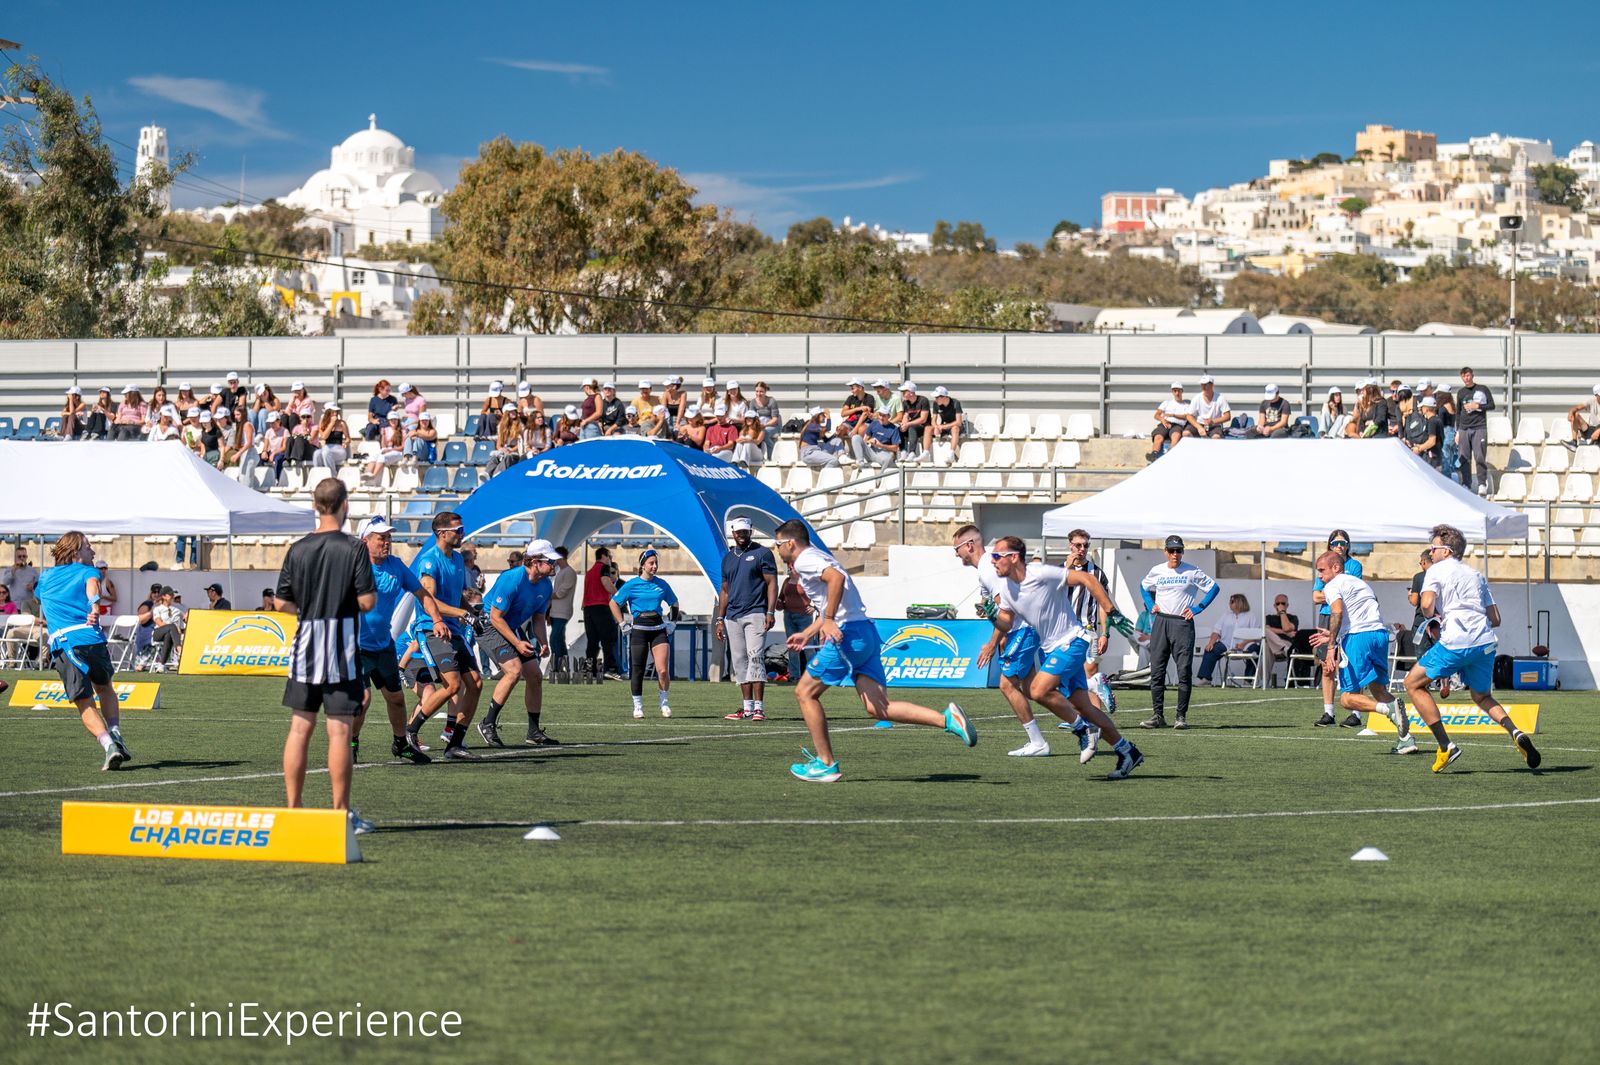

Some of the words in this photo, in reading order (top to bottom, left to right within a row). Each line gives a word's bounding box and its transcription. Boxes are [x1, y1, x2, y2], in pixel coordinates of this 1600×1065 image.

[525, 459, 664, 480] Stoiximan
[203, 644, 231, 655] LOS
[199, 654, 290, 668] CHARGERS
[880, 656, 898, 667] OS
[901, 657, 971, 667] ANGELES
[884, 666, 966, 682] ARGERS
[133, 808, 175, 826] LOS
[179, 810, 276, 829] ANGELES
[129, 826, 271, 850] CHARGERS
